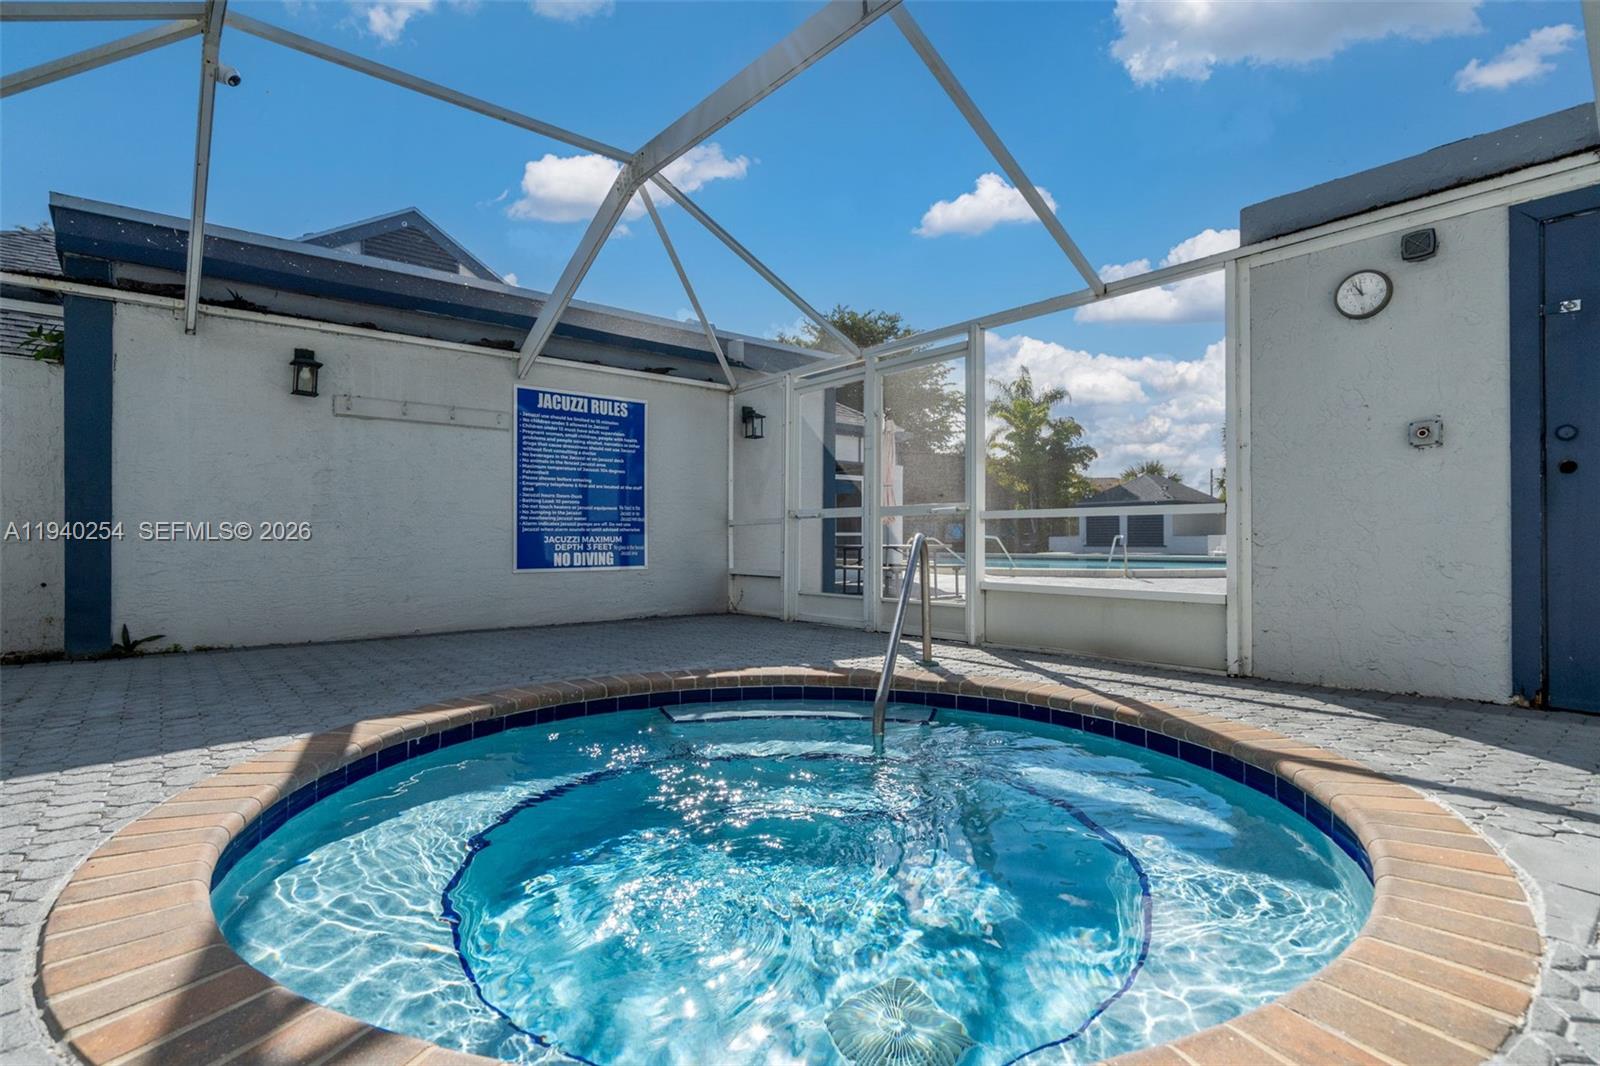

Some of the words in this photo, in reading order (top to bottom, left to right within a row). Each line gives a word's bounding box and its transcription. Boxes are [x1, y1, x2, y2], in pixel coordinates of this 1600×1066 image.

[537, 392, 588, 413] JACUZZI
[591, 400, 629, 418] RULES
[544, 536, 580, 544] JACUZZI
[554, 552, 571, 567] NO
[574, 551, 614, 566] DIVING
